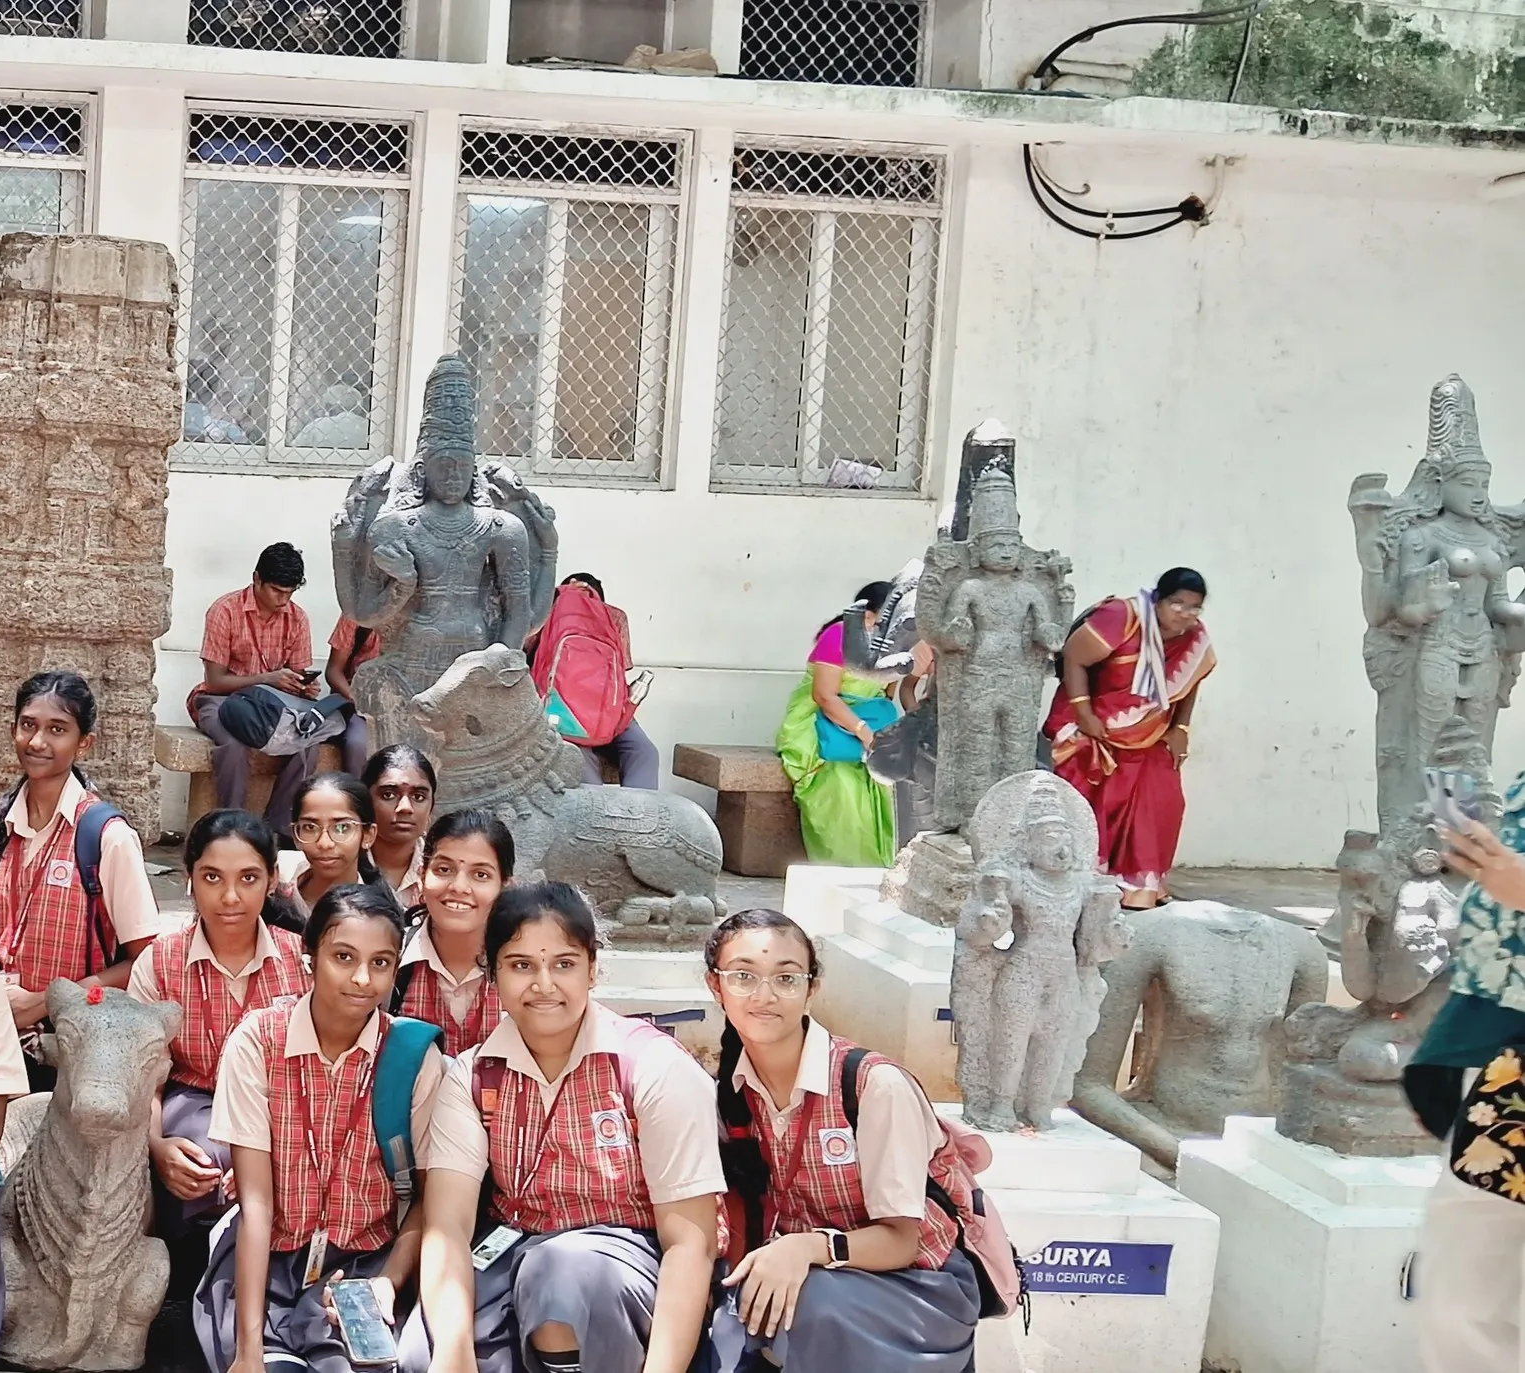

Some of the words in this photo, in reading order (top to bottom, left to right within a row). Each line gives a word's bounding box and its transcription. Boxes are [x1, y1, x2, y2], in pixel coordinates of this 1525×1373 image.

[1032, 1271, 1044, 1282] 18
[1045, 1272, 1054, 1282] th
[1056, 1272, 1107, 1284] CENTURY
